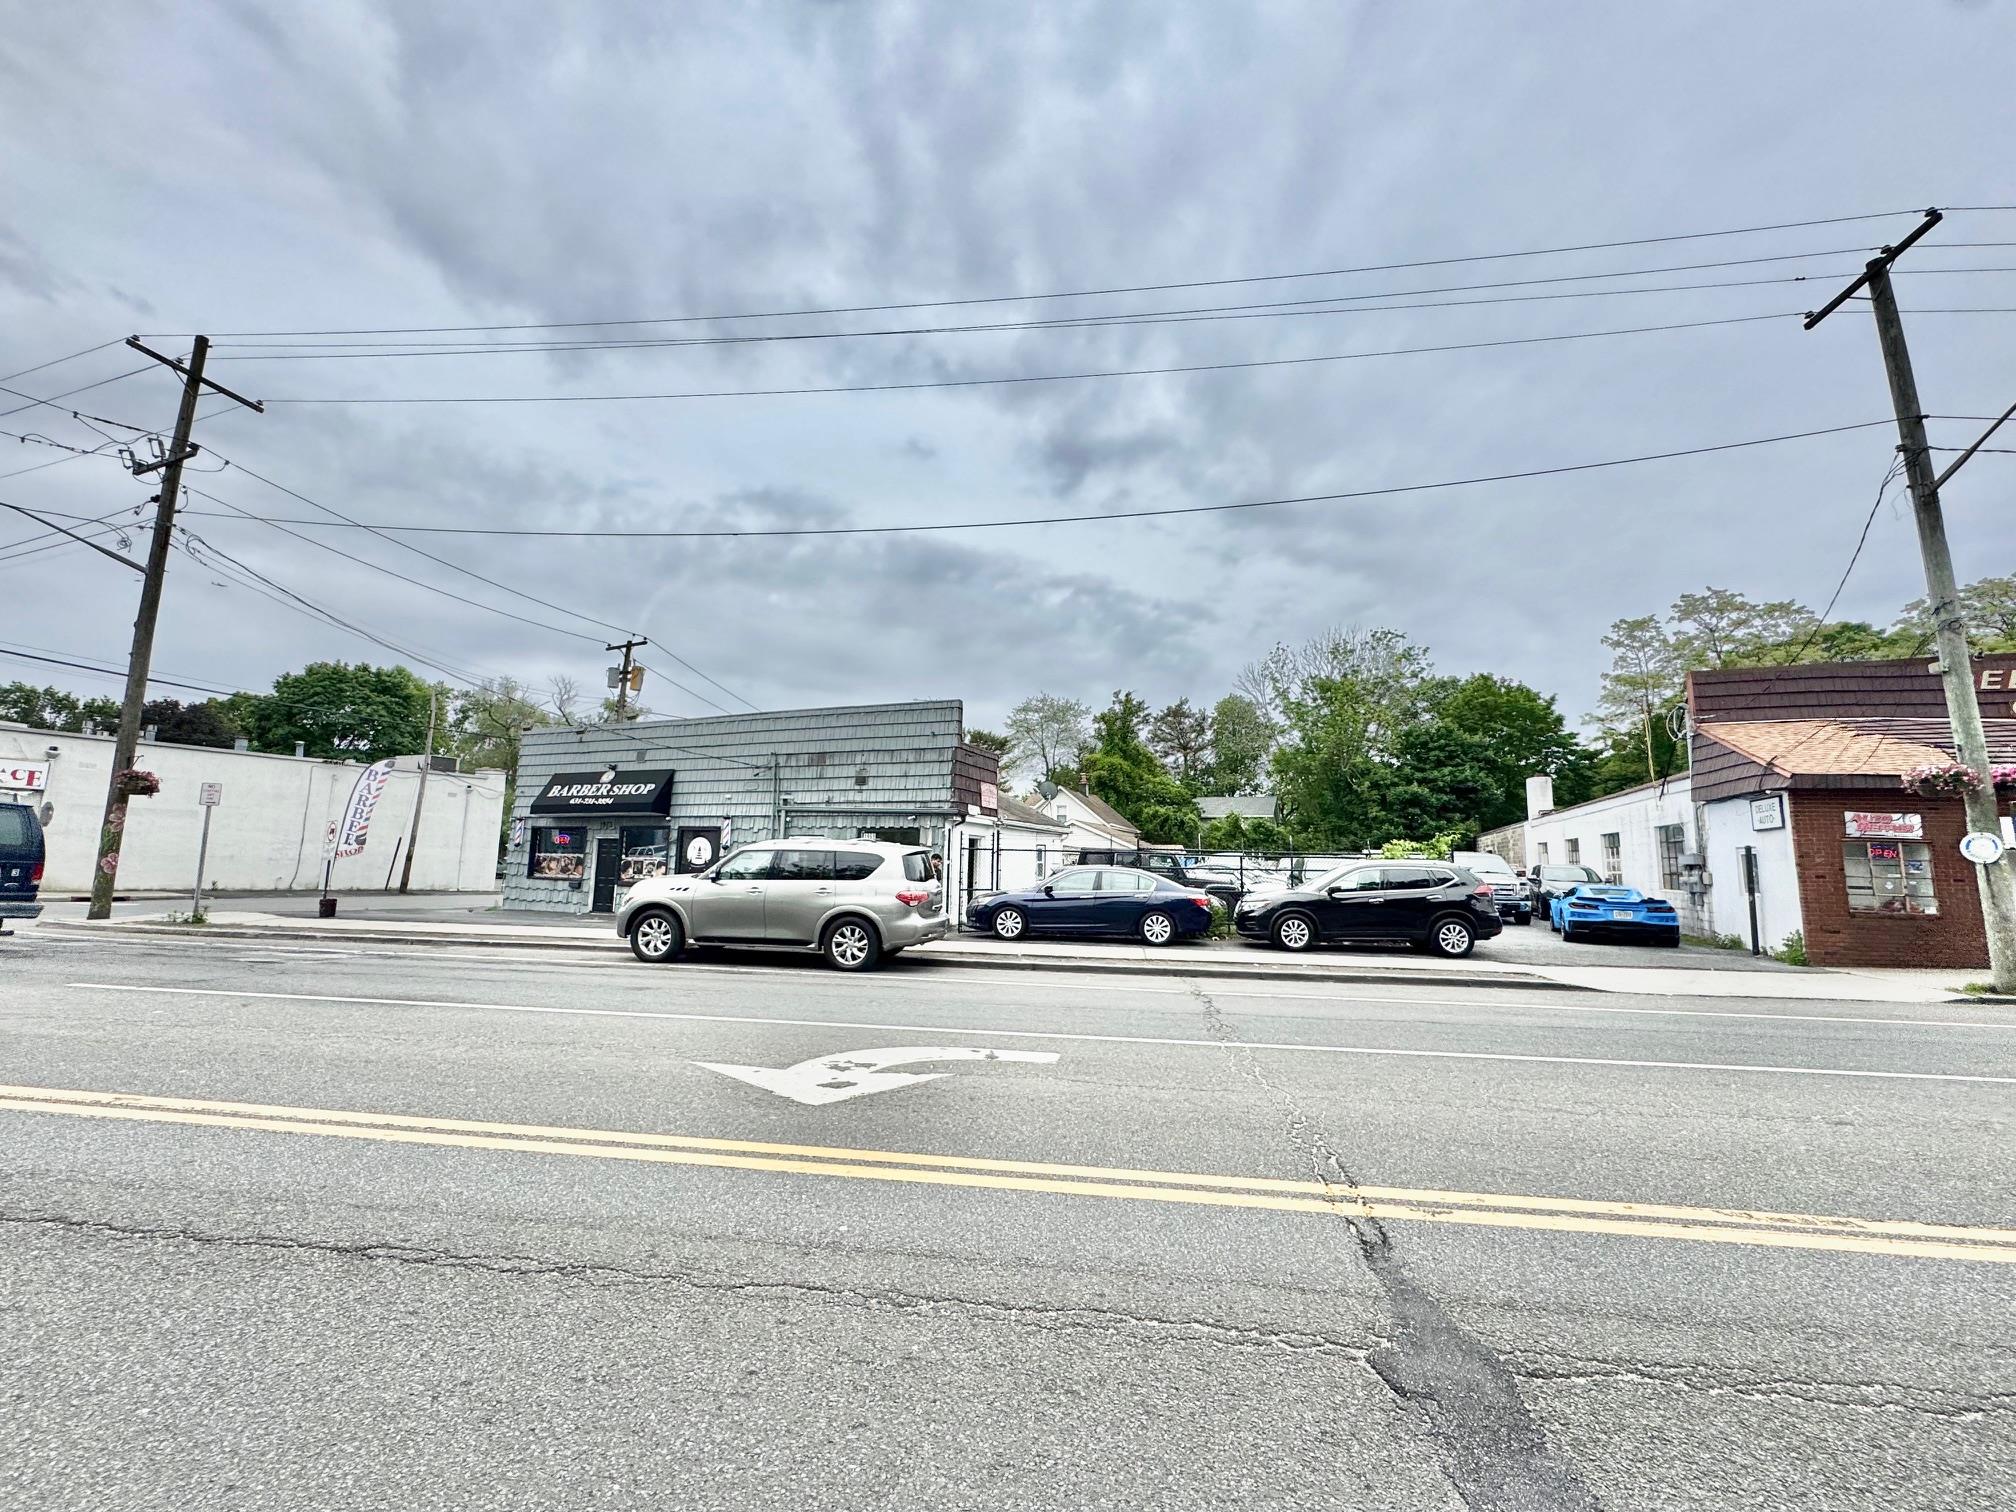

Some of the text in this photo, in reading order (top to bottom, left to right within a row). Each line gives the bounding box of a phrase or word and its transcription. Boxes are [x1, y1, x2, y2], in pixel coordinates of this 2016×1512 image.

[547, 783, 656, 797] BARBER SHOP
[1870, 849, 1897, 858] OPEN
